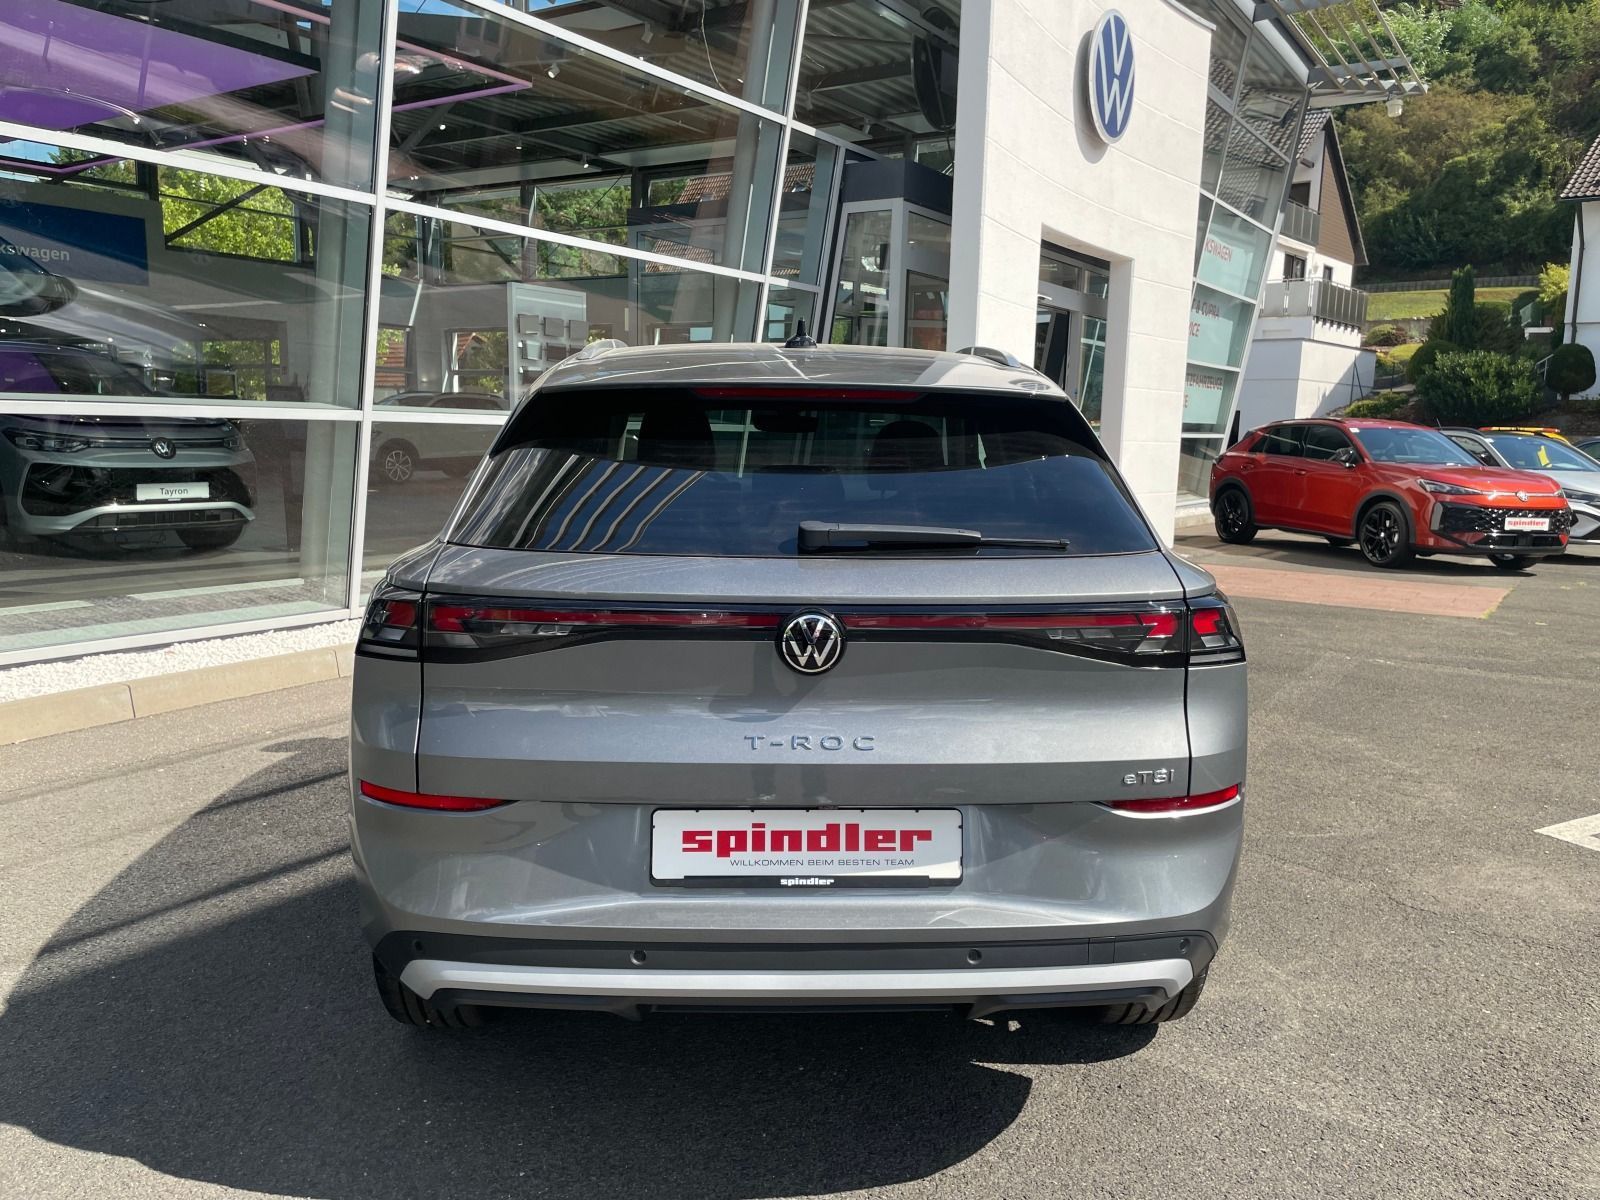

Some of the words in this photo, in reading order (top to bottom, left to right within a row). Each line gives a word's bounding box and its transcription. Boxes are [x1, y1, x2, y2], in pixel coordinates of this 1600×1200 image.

[160, 487, 188, 497] Tayron
[784, 616, 841, 670] VW
[744, 735, 875, 751] T-ROC
[1123, 768, 1175, 785] eTSI
[682, 823, 932, 857] spindler
[780, 877, 835, 886] spindler
